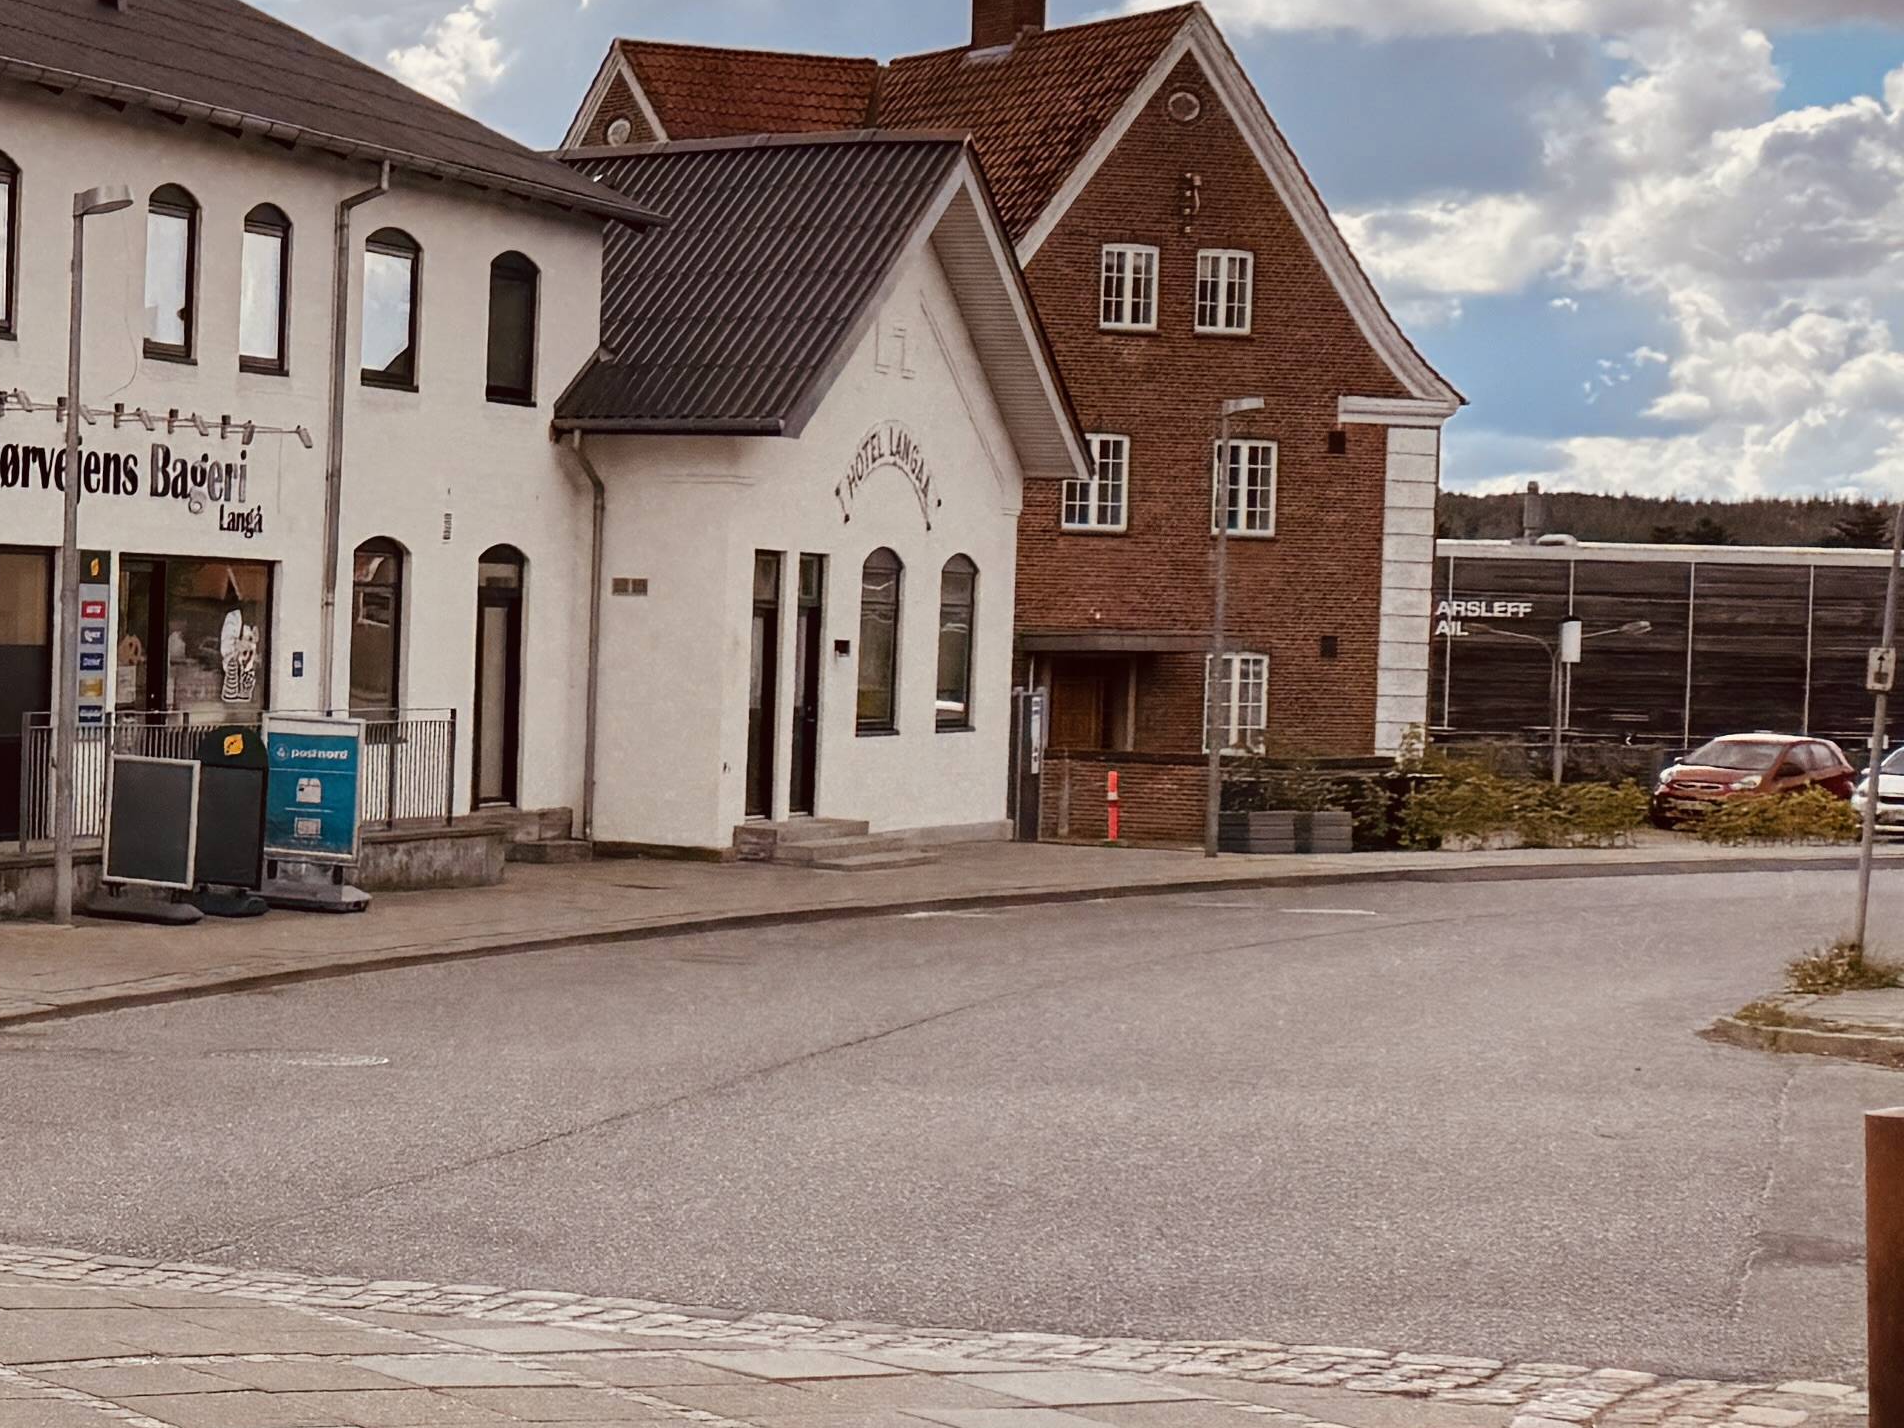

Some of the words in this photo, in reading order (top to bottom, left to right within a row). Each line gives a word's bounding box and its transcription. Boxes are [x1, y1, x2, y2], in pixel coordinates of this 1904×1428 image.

[149, 443, 248, 514] Bageri
[847, 430, 885, 500] HOTEL
[218, 503, 264, 538] Langå
[1435, 600, 1533, 618] ARSLEFF
[290, 748, 348, 760] postnord
